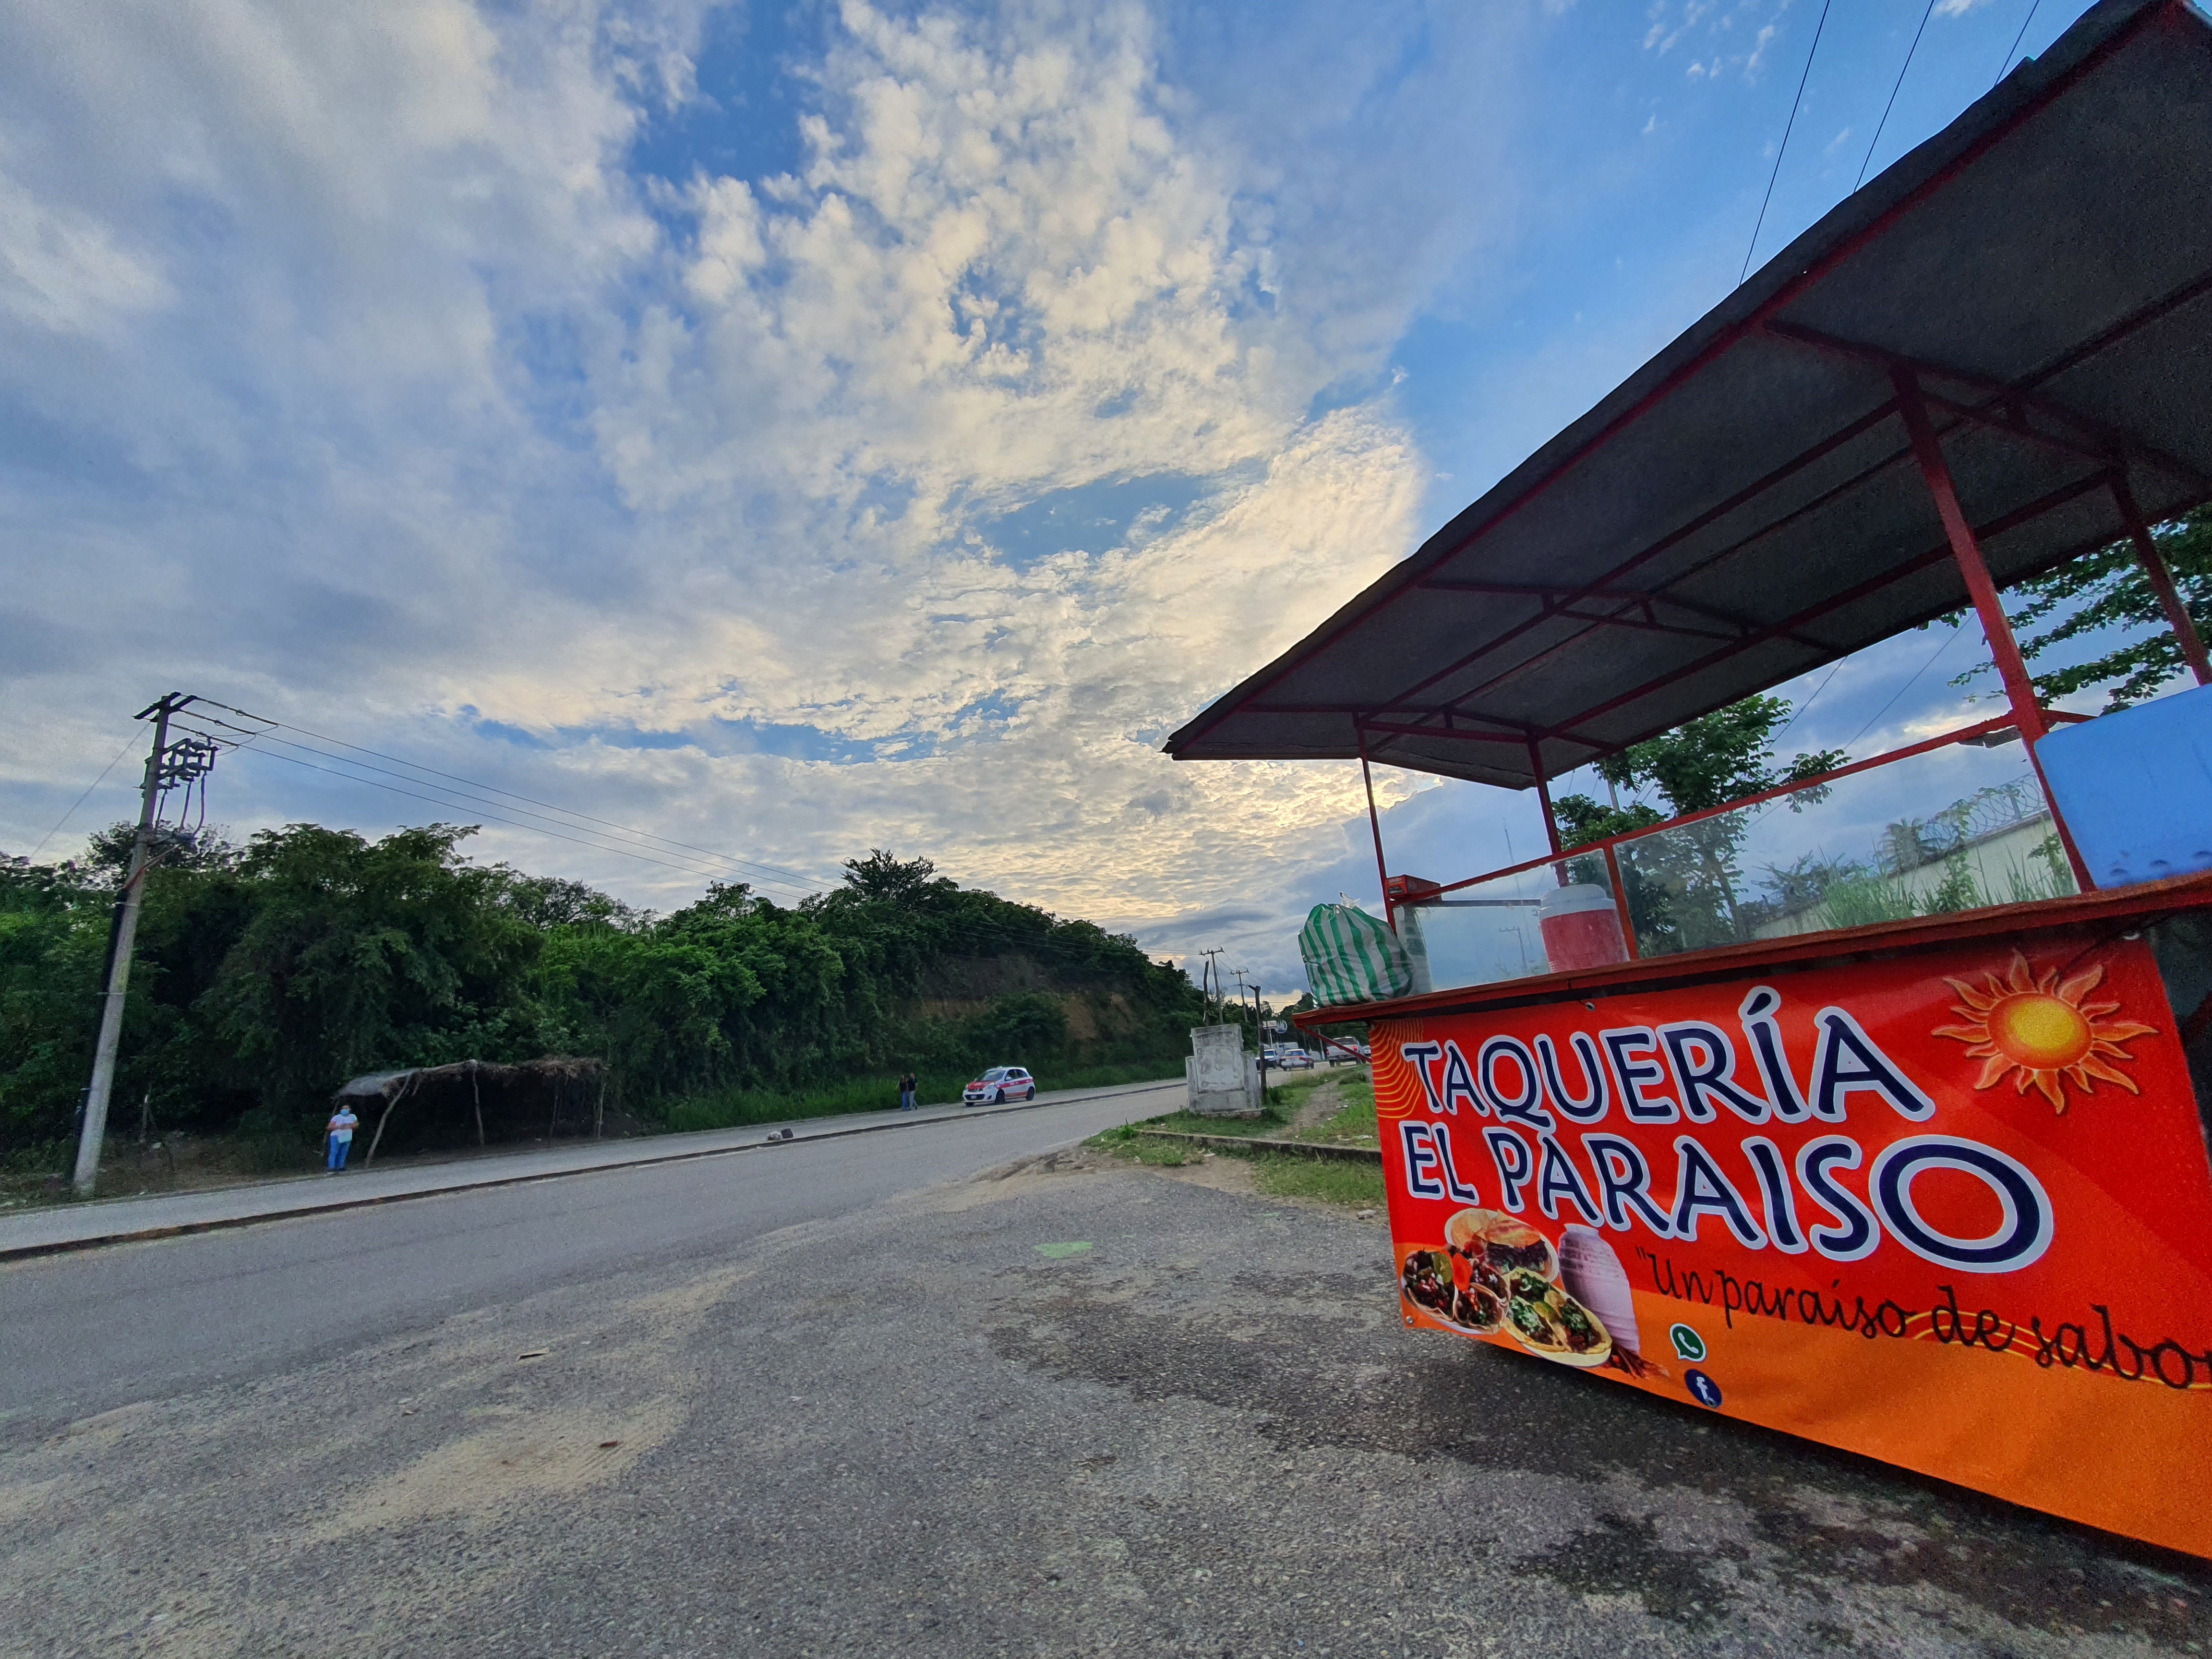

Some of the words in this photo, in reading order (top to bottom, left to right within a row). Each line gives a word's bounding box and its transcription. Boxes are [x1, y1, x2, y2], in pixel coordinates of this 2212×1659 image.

[1400, 986, 1936, 1133] TAQUERÍA
[1400, 1121, 1479, 1205] EL
[1482, 1127, 2054, 1273] PARAISO
[1713, 1270, 1917, 1339] paraíso
[1931, 1284, 2015, 1352] de
[2031, 1302, 2212, 1389] sabo
